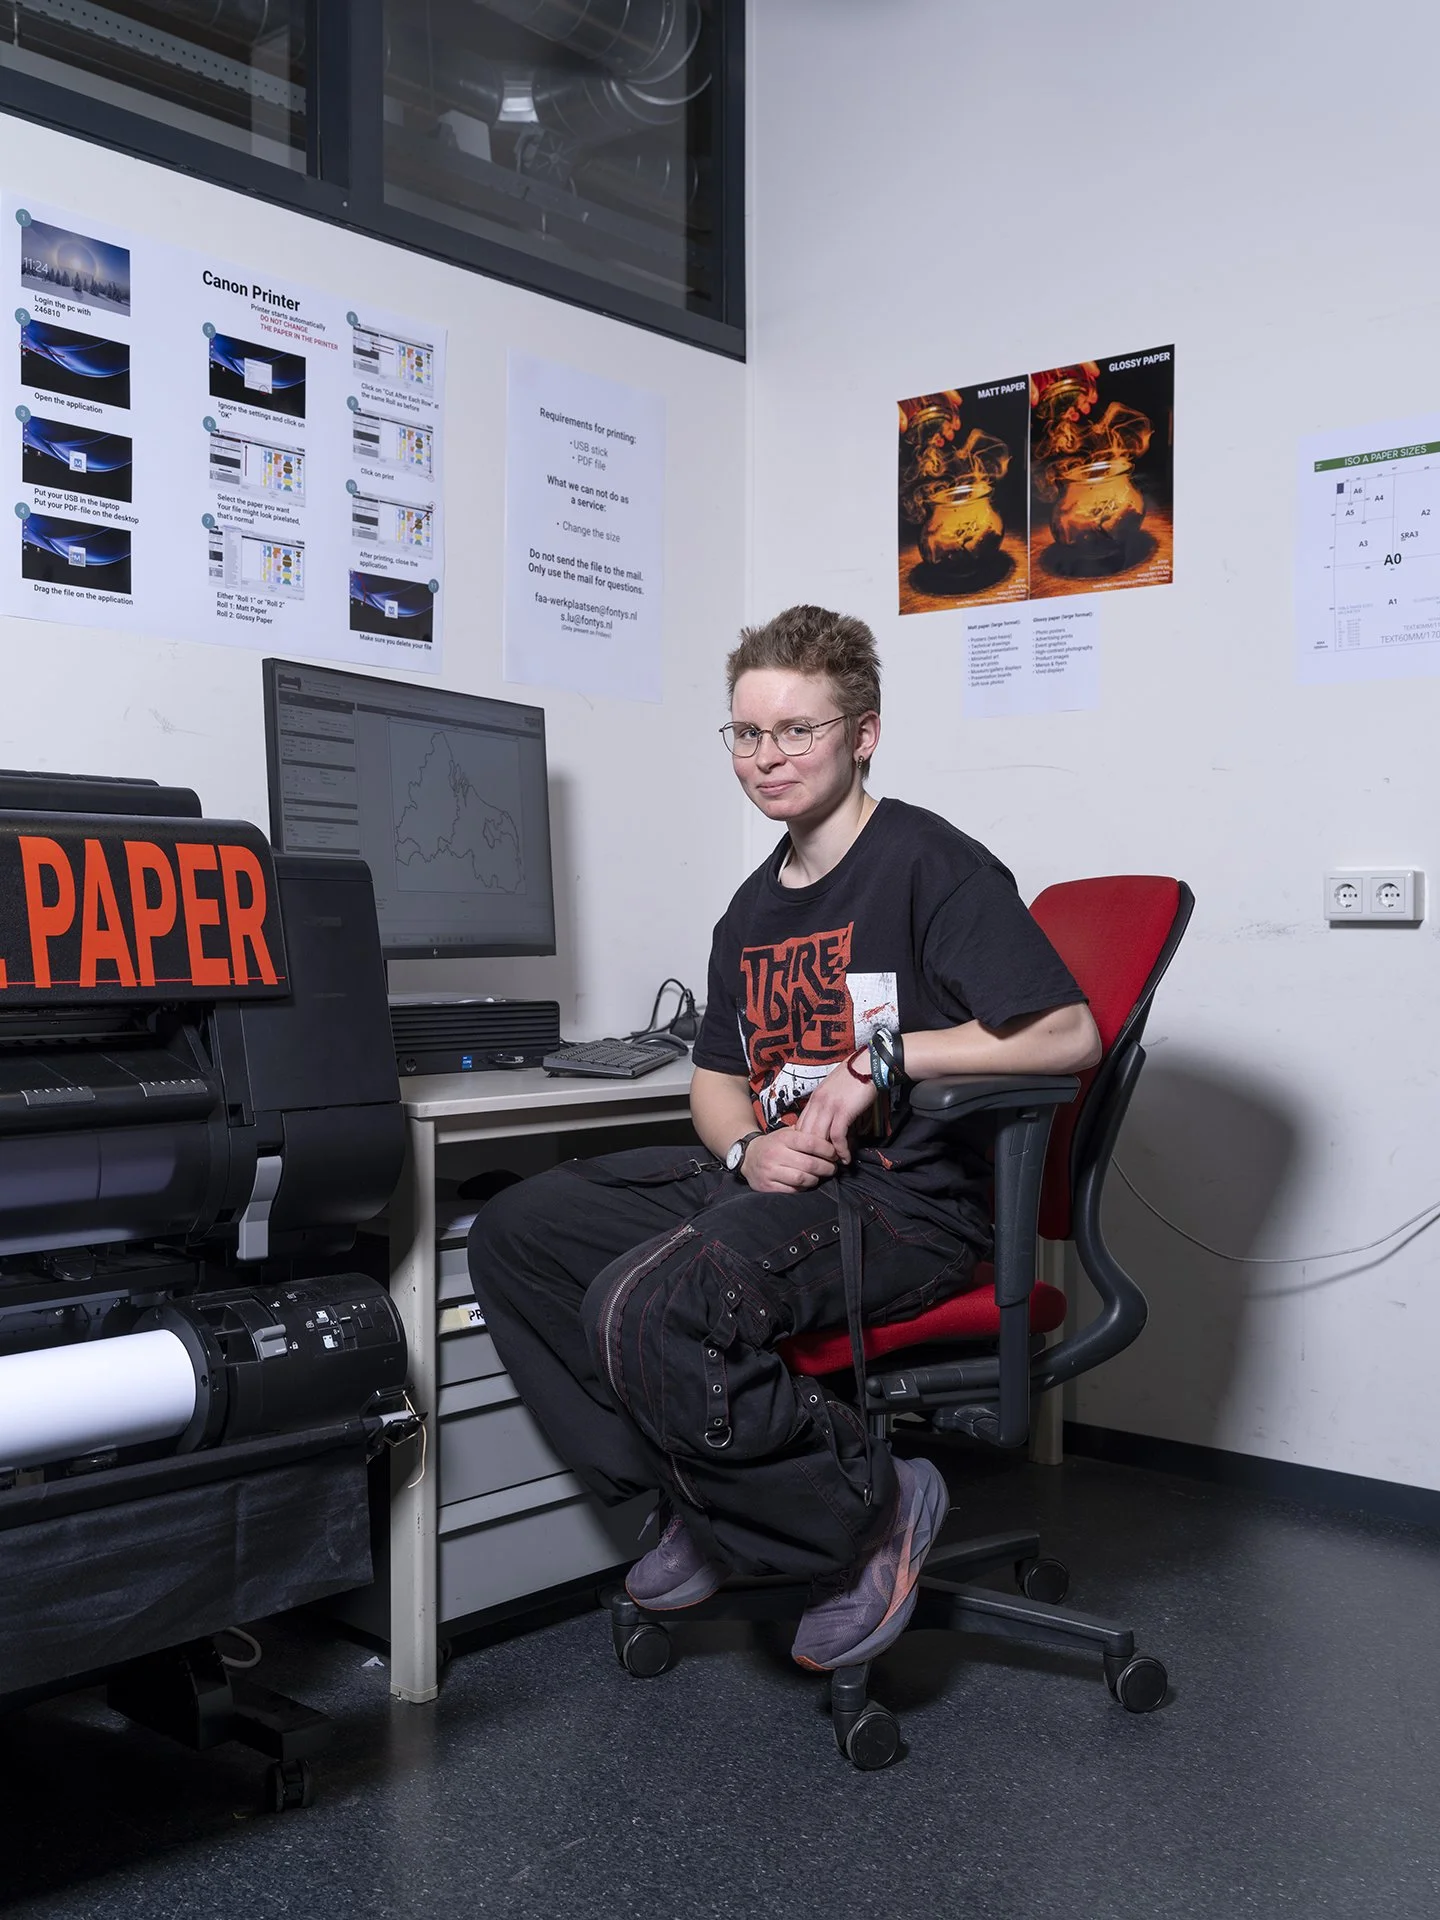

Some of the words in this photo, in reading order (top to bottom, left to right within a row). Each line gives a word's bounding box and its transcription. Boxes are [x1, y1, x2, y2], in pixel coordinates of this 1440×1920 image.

[23, 257, 48, 274] 11:24
[203, 271, 248, 296] Canon
[253, 285, 300, 311] Printer
[34, 295, 54, 308] Login
[55, 301, 66, 309] the
[77, 308, 91, 316] with
[35, 305, 61, 317] 246810
[251, 304, 271, 314] Printer
[271, 311, 288, 321] starts
[289, 316, 326, 331] automatically
[260, 314, 269, 322] DO
[270, 317, 283, 325] NOT
[283, 321, 308, 333] CHANGE
[261, 323, 272, 332] THE
[273, 327, 293, 337] PAPER
[301, 335, 313, 343] THE
[314, 338, 338, 350] PRINTER
[1109, 358, 1142, 373] GLOSSY
[1143, 352, 1170, 368] PAPER
[978, 384, 1000, 399] MATT
[1001, 381, 1026, 396] PAPER
[34, 392, 53, 402] Open
[54, 397, 65, 405] the
[66, 401, 103, 413] application
[218, 402, 237, 414] Ignore
[248, 410, 271, 420] settings
[284, 418, 297, 426] click
[540, 408, 593, 430] Requirements
[594, 423, 605, 434] for
[607, 429, 636, 445] printing:
[573, 440, 590, 452] USB
[591, 446, 608, 457] stick
[1345, 456, 1360, 466] ISO
[1362, 455, 1369, 463] A
[1371, 450, 1398, 462] PAPER
[1400, 445, 1427, 457] SIZES
[577, 455, 593, 466] PDF
[594, 459, 606, 471] file
[34, 488, 46, 496] Put
[64, 494, 79, 503] USB
[80, 496, 86, 504] in
[87, 498, 98, 506] the
[99, 500, 120, 511] laptop
[217, 494, 236, 503] Select
[547, 475, 567, 488] What
[568, 482, 579, 491] we
[580, 486, 594, 495] can
[596, 490, 608, 499] not
[609, 491, 619, 501] do
[620, 496, 629, 504] as
[34, 498, 46, 506] Put
[64, 503, 91, 514] PDF-file
[102, 511, 113, 519] the
[114, 513, 139, 524] desktop
[217, 503, 231, 513] Your
[232, 505, 241, 513] file
[242, 509, 259, 519] might
[260, 511, 272, 519] look
[273, 515, 300, 525] pixelated,
[571, 497, 576, 505] a
[577, 499, 606, 512] service:
[1345, 509, 1355, 517] A5
[1421, 509, 1431, 517] A2
[217, 512, 233, 520] that's
[234, 516, 254, 524] normal
[563, 521, 591, 537] Change
[592, 528, 604, 539] the
[606, 532, 621, 543] size
[530, 548, 541, 559] Do
[542, 553, 555, 562] not
[557, 556, 575, 566] send
[577, 559, 589, 570] the
[590, 561, 603, 572] file
[604, 565, 612, 574] to
[613, 567, 625, 577] the
[626, 571, 643, 581] mail.
[1384, 553, 1402, 566] A0
[528, 563, 546, 576] Only
[547, 569, 562, 578] use
[563, 570, 576, 581] the
[577, 575, 594, 584] mail
[595, 576, 606, 587] for
[607, 581, 644, 594] questions.
[34, 584, 50, 595] Drag
[51, 587, 62, 595] the
[64, 589, 75, 597] file
[86, 592, 97, 600] the
[98, 596, 134, 605] application
[236, 604, 249, 612] Matt
[250, 606, 267, 615] Paper
[535, 592, 637, 620] faa-werkplaatsen@fontys.nl
[236, 613, 255, 623] Glossy
[256, 616, 273, 624] Paper
[560, 613, 613, 629] s.lu@fontys.nl
[18, 835, 278, 989] PAPER
